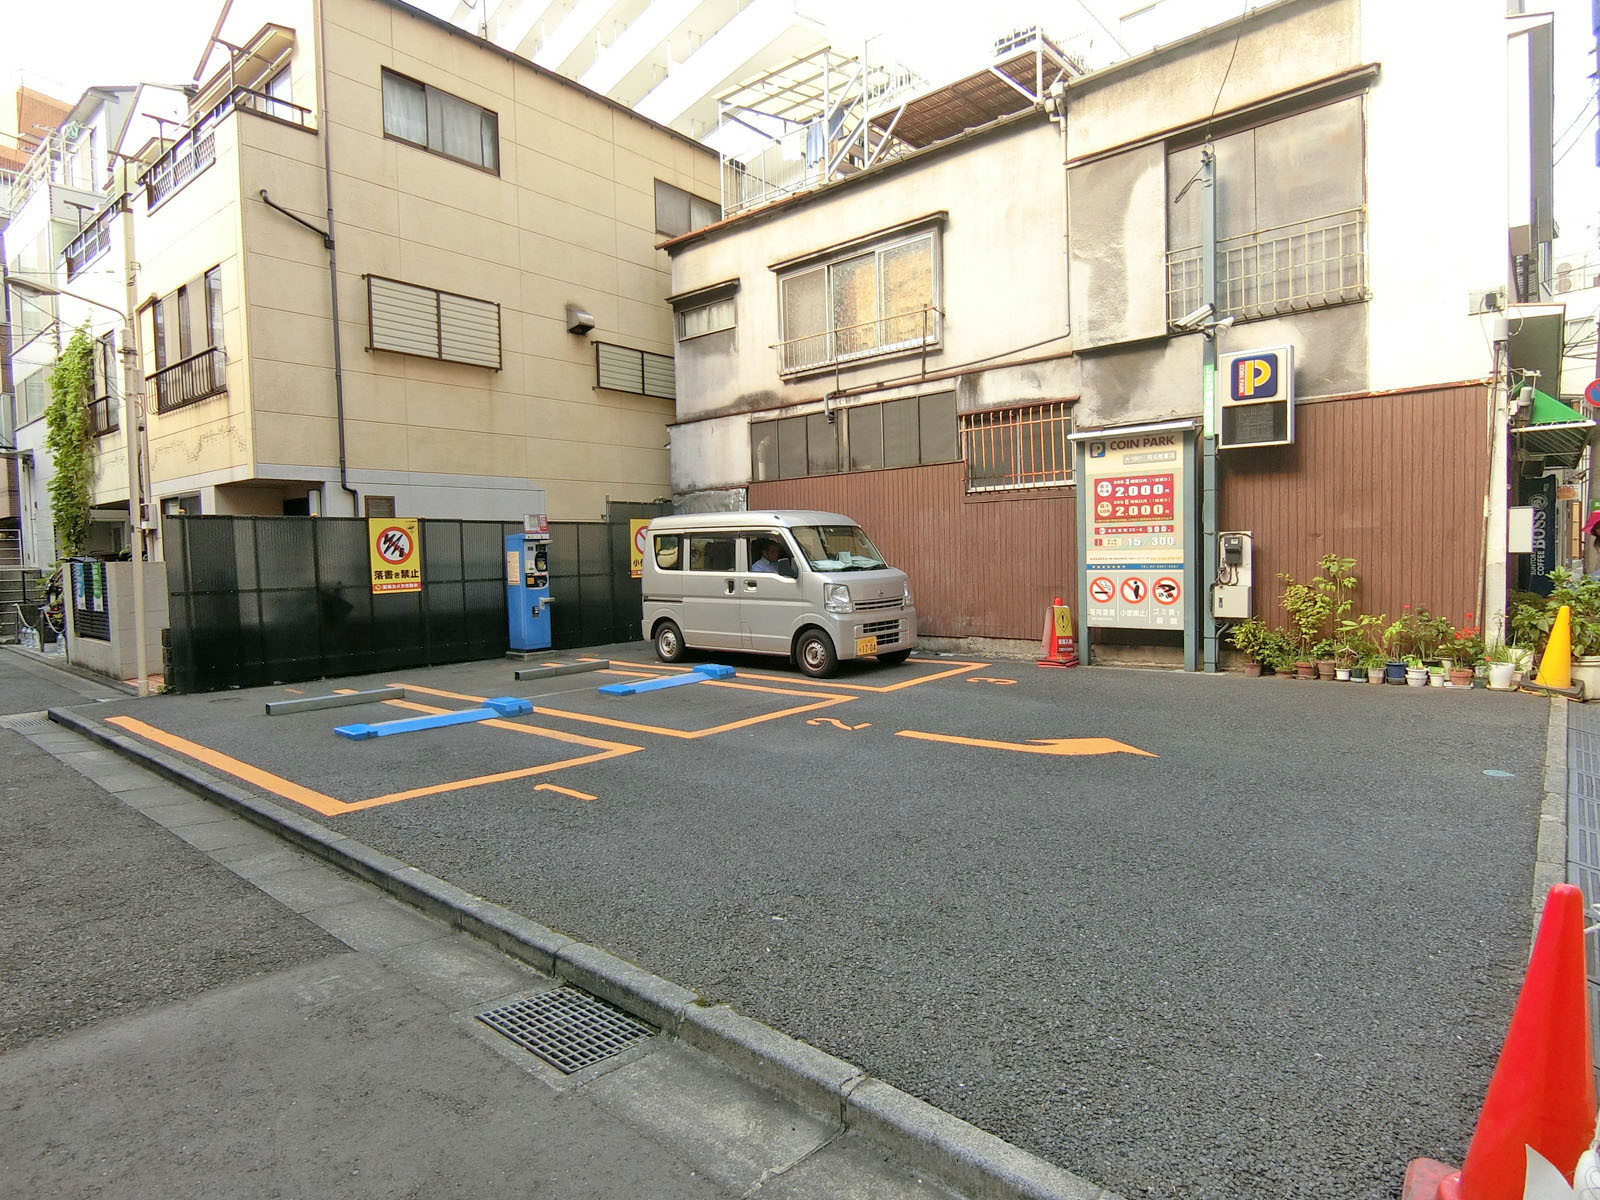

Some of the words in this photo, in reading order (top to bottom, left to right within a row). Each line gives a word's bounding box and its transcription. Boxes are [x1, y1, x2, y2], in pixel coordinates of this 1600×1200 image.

[1109, 439, 1139, 450] COIN
[1143, 434, 1174, 448] PARK
[1534, 511, 1547, 549] BOSS
[1537, 550, 1545, 576] COFFEE
[374, 569, 419, 580] 落書き禁止
[966, 676, 1018, 686] 3
[806, 716, 873, 731] 2
[533, 783, 597, 801] 1
